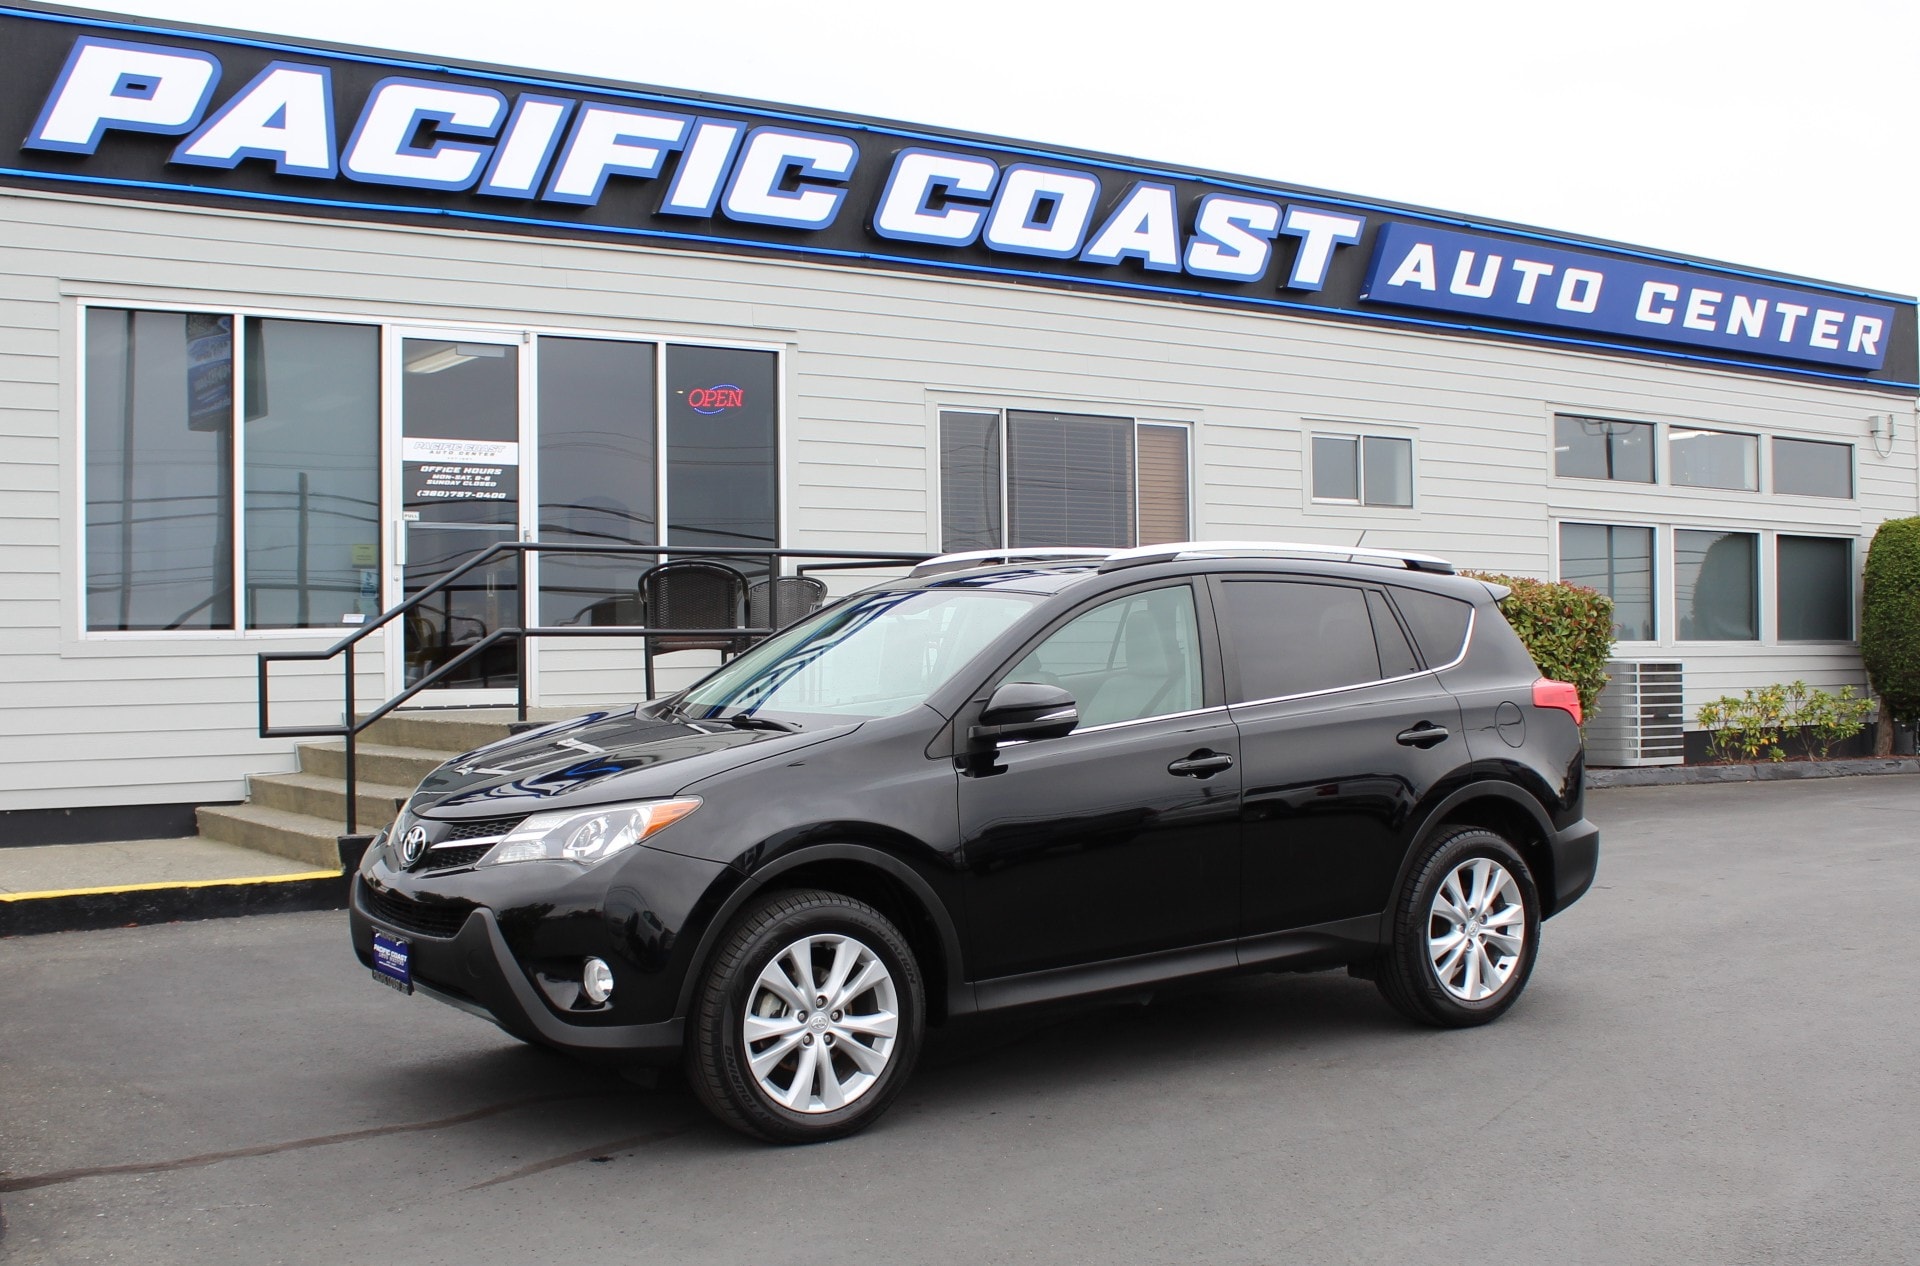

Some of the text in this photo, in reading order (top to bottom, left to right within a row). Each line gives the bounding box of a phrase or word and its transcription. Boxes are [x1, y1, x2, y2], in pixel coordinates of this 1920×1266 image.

[22, 35, 1367, 292] PACIFIC COAST
[1387, 243, 1884, 356] AUTO CENTER
[688, 388, 744, 407] OPEN
[413, 442, 506, 453] PACIFIC COAST
[420, 465, 503, 475] OFFICE HOURS
